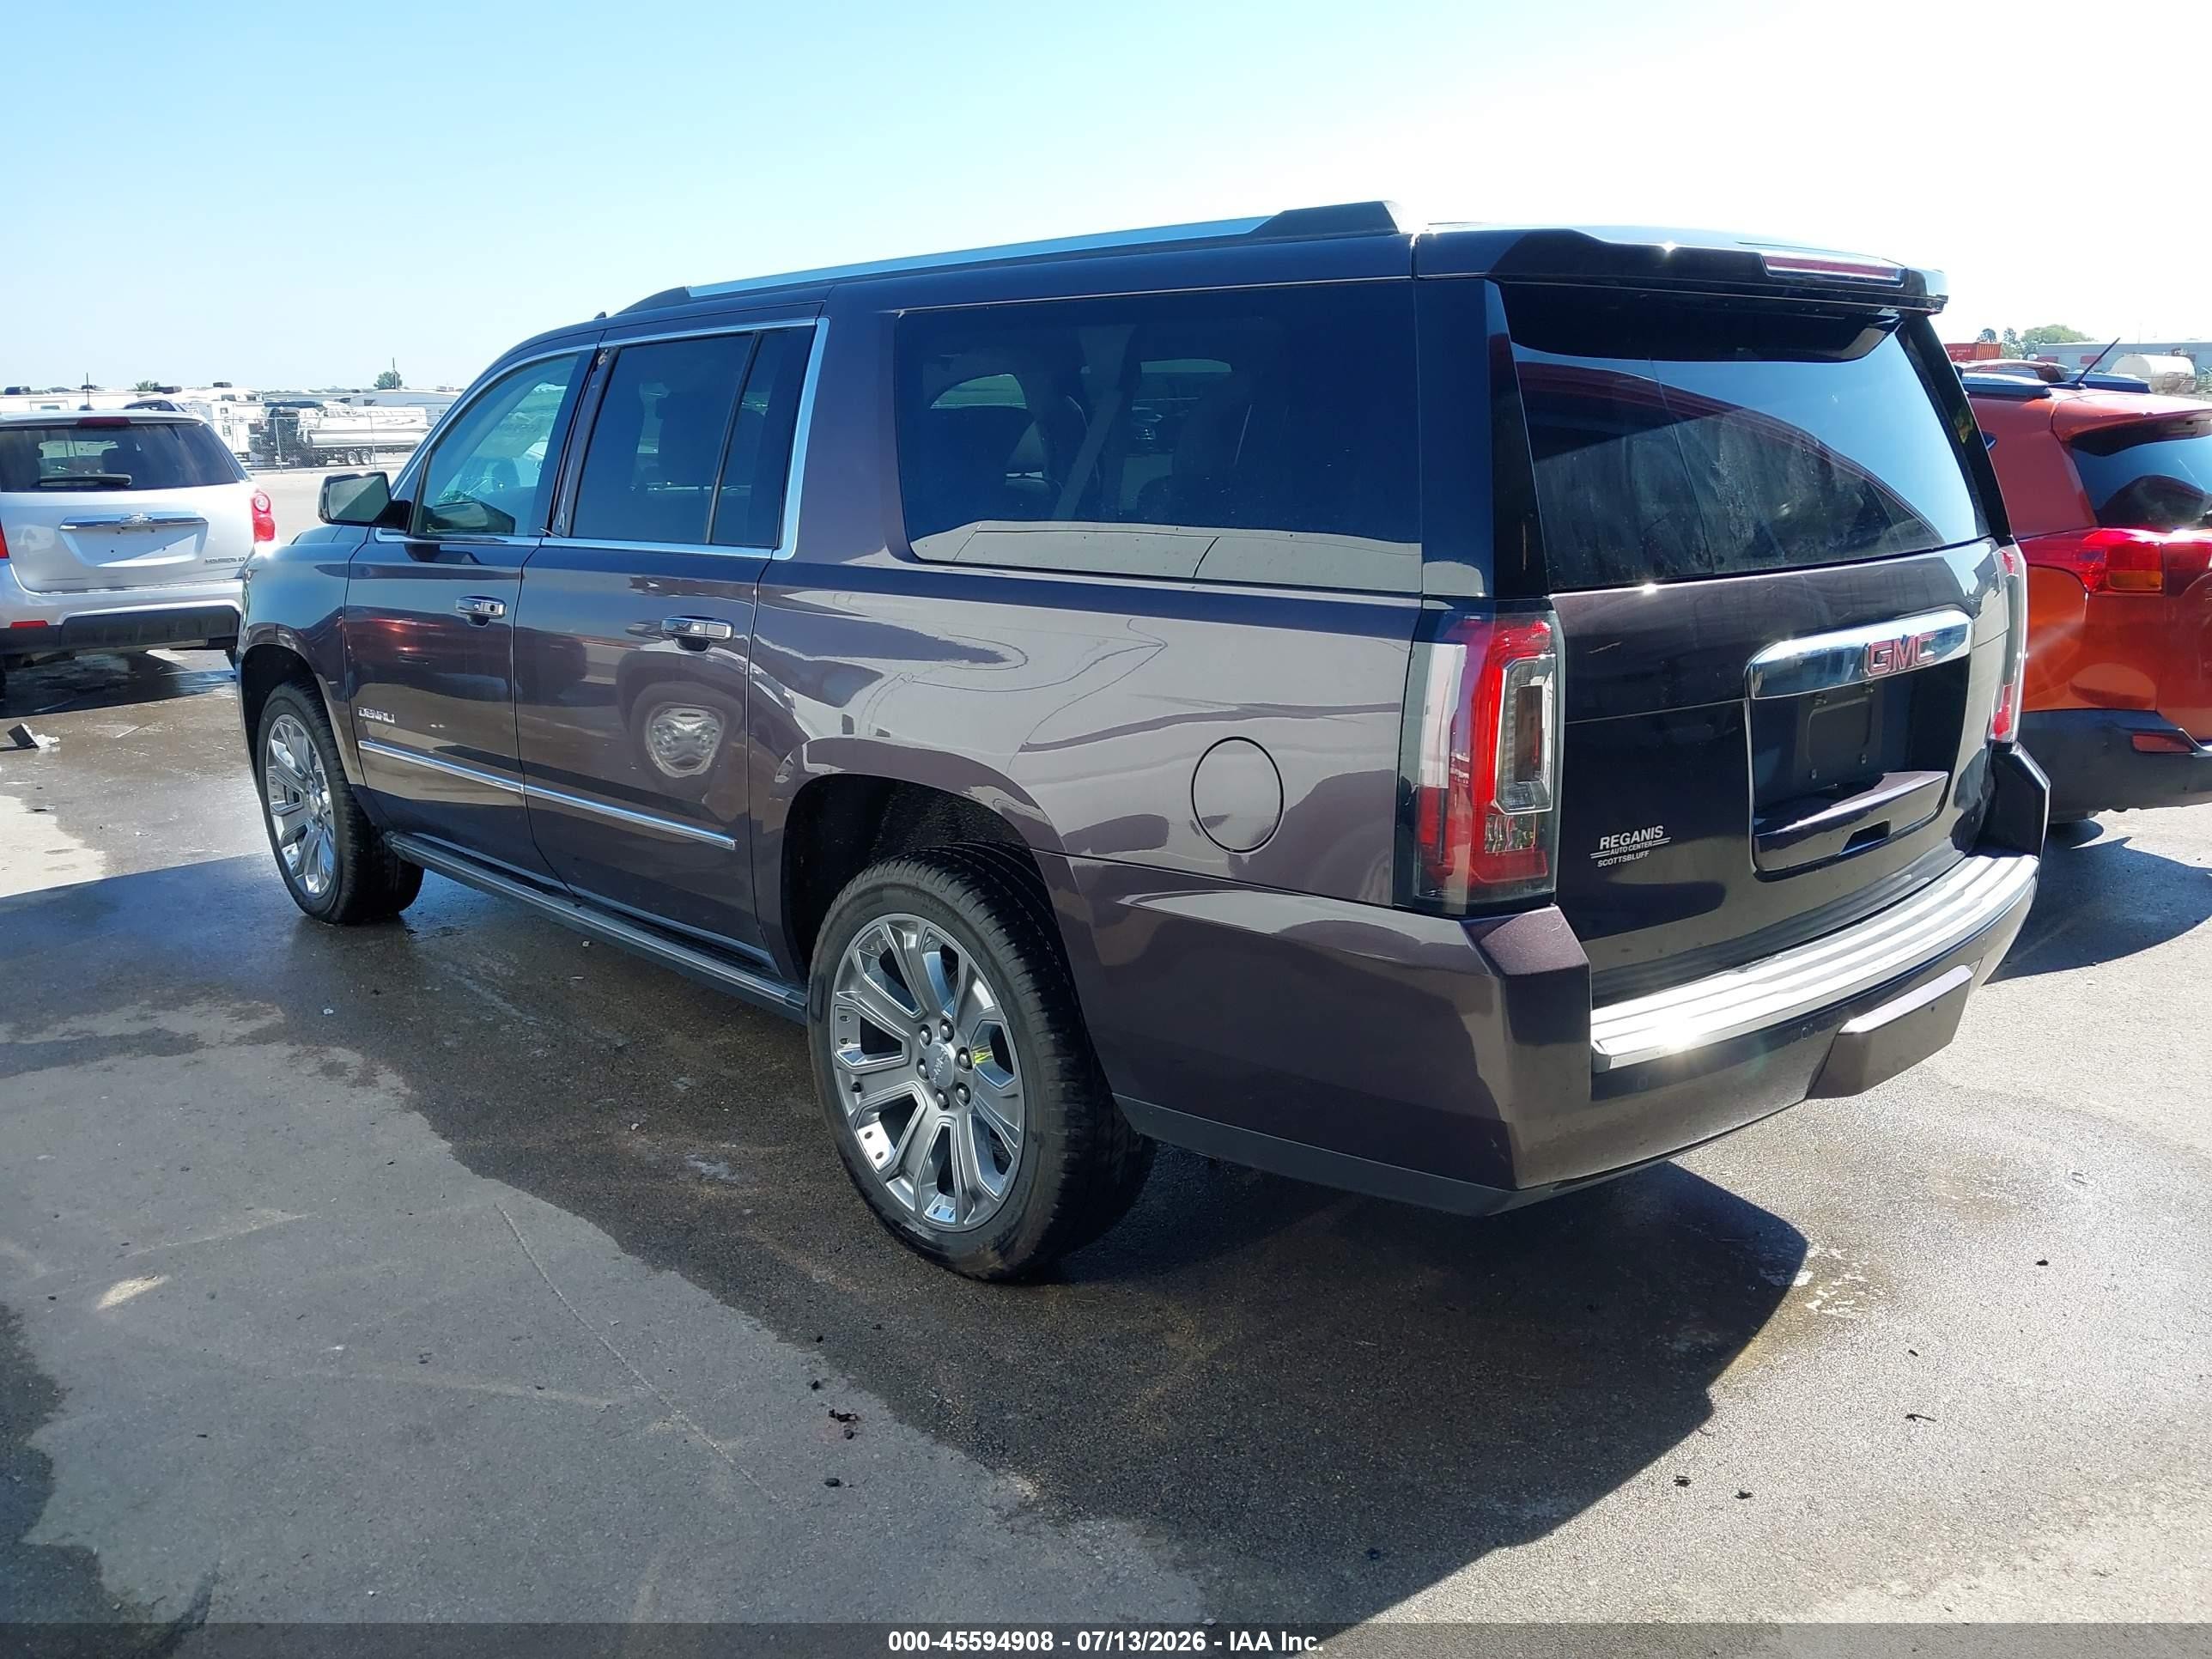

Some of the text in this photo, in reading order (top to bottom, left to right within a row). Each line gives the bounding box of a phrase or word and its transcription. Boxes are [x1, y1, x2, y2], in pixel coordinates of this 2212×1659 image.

[1865, 631, 1937, 677] GMC
[1600, 825, 1664, 850] REGANIS
[1610, 841, 1653, 855] AUTO CENTER
[1597, 850, 1650, 867] SCOTTSBLUFF
